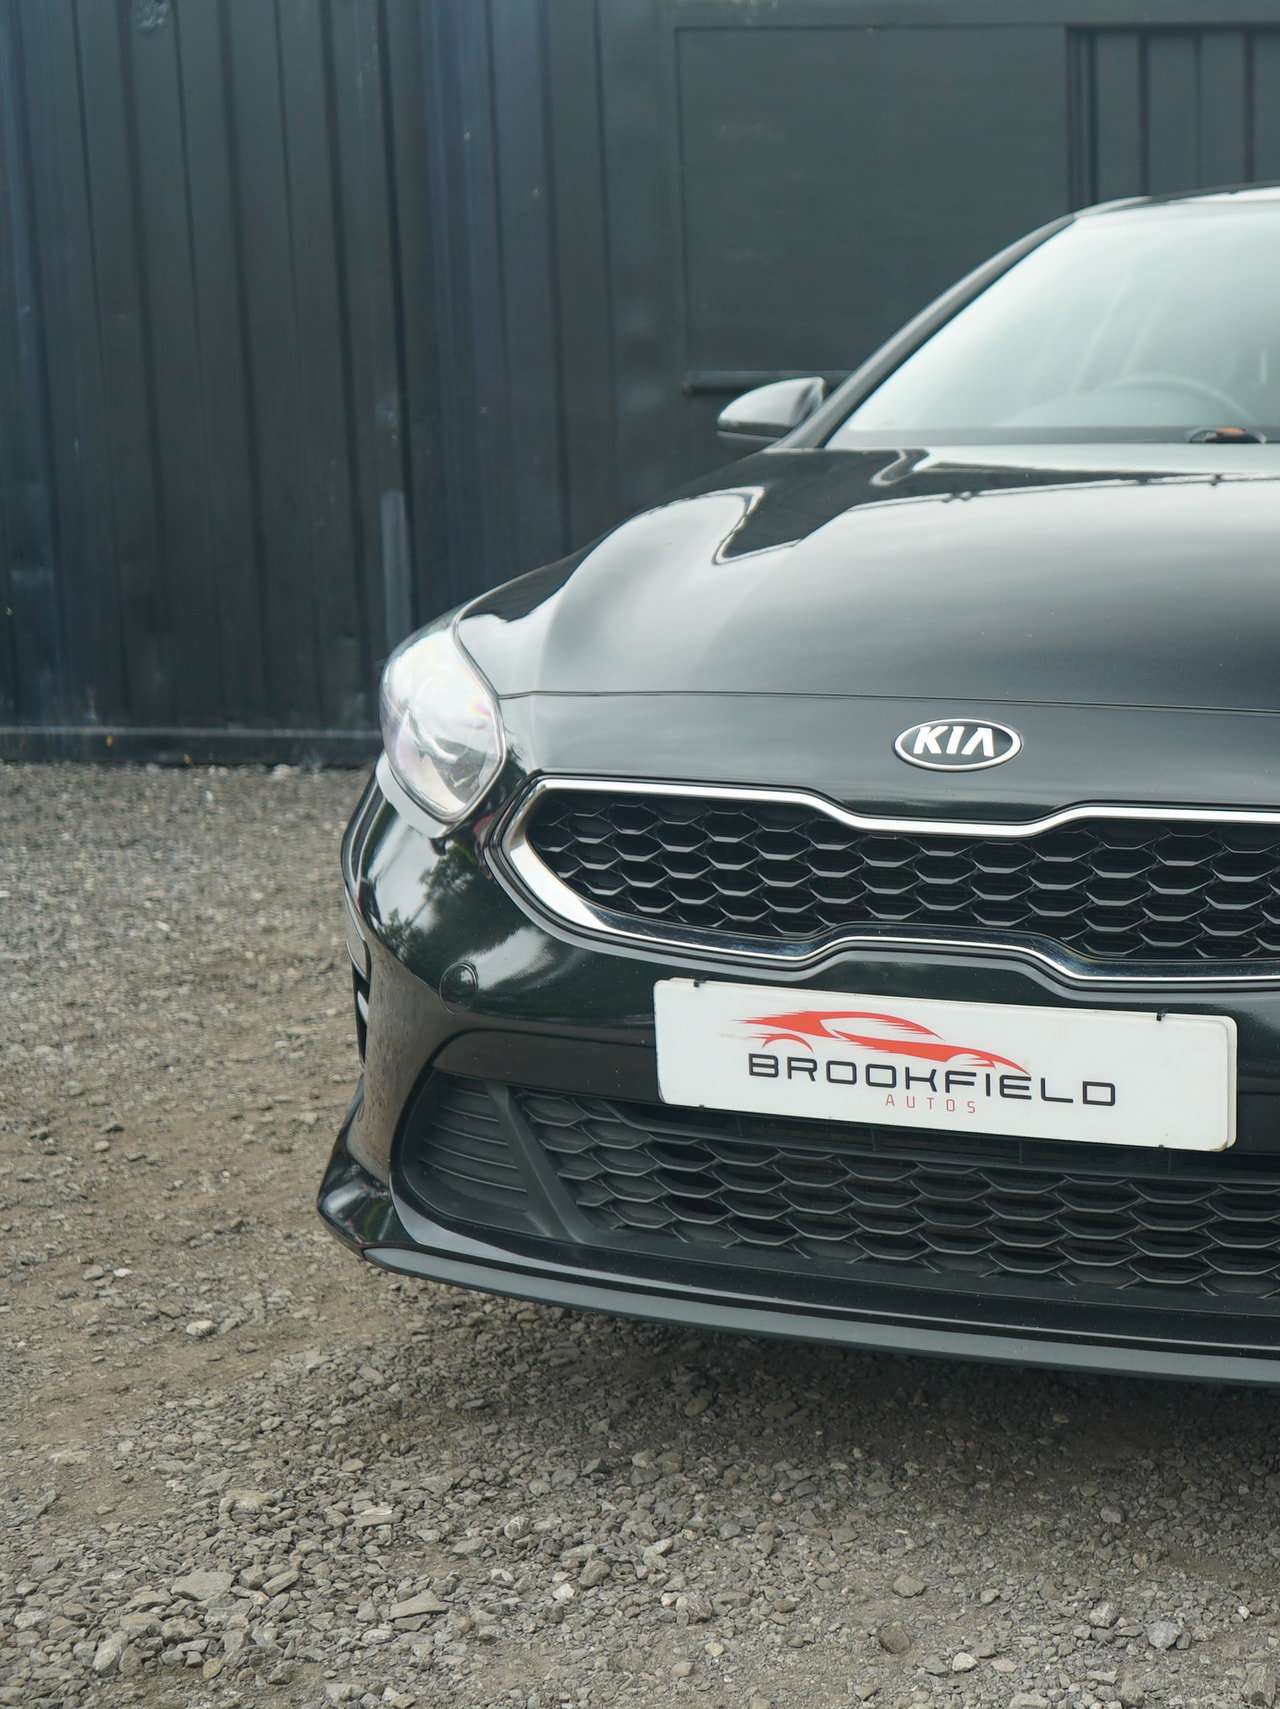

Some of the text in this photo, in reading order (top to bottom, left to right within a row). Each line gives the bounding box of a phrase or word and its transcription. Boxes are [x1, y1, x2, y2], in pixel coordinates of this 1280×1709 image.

[913, 725, 994, 757] KIA
[748, 1053, 1117, 1107] BROOKFIELD
[885, 1093, 977, 1115] AUTOS
